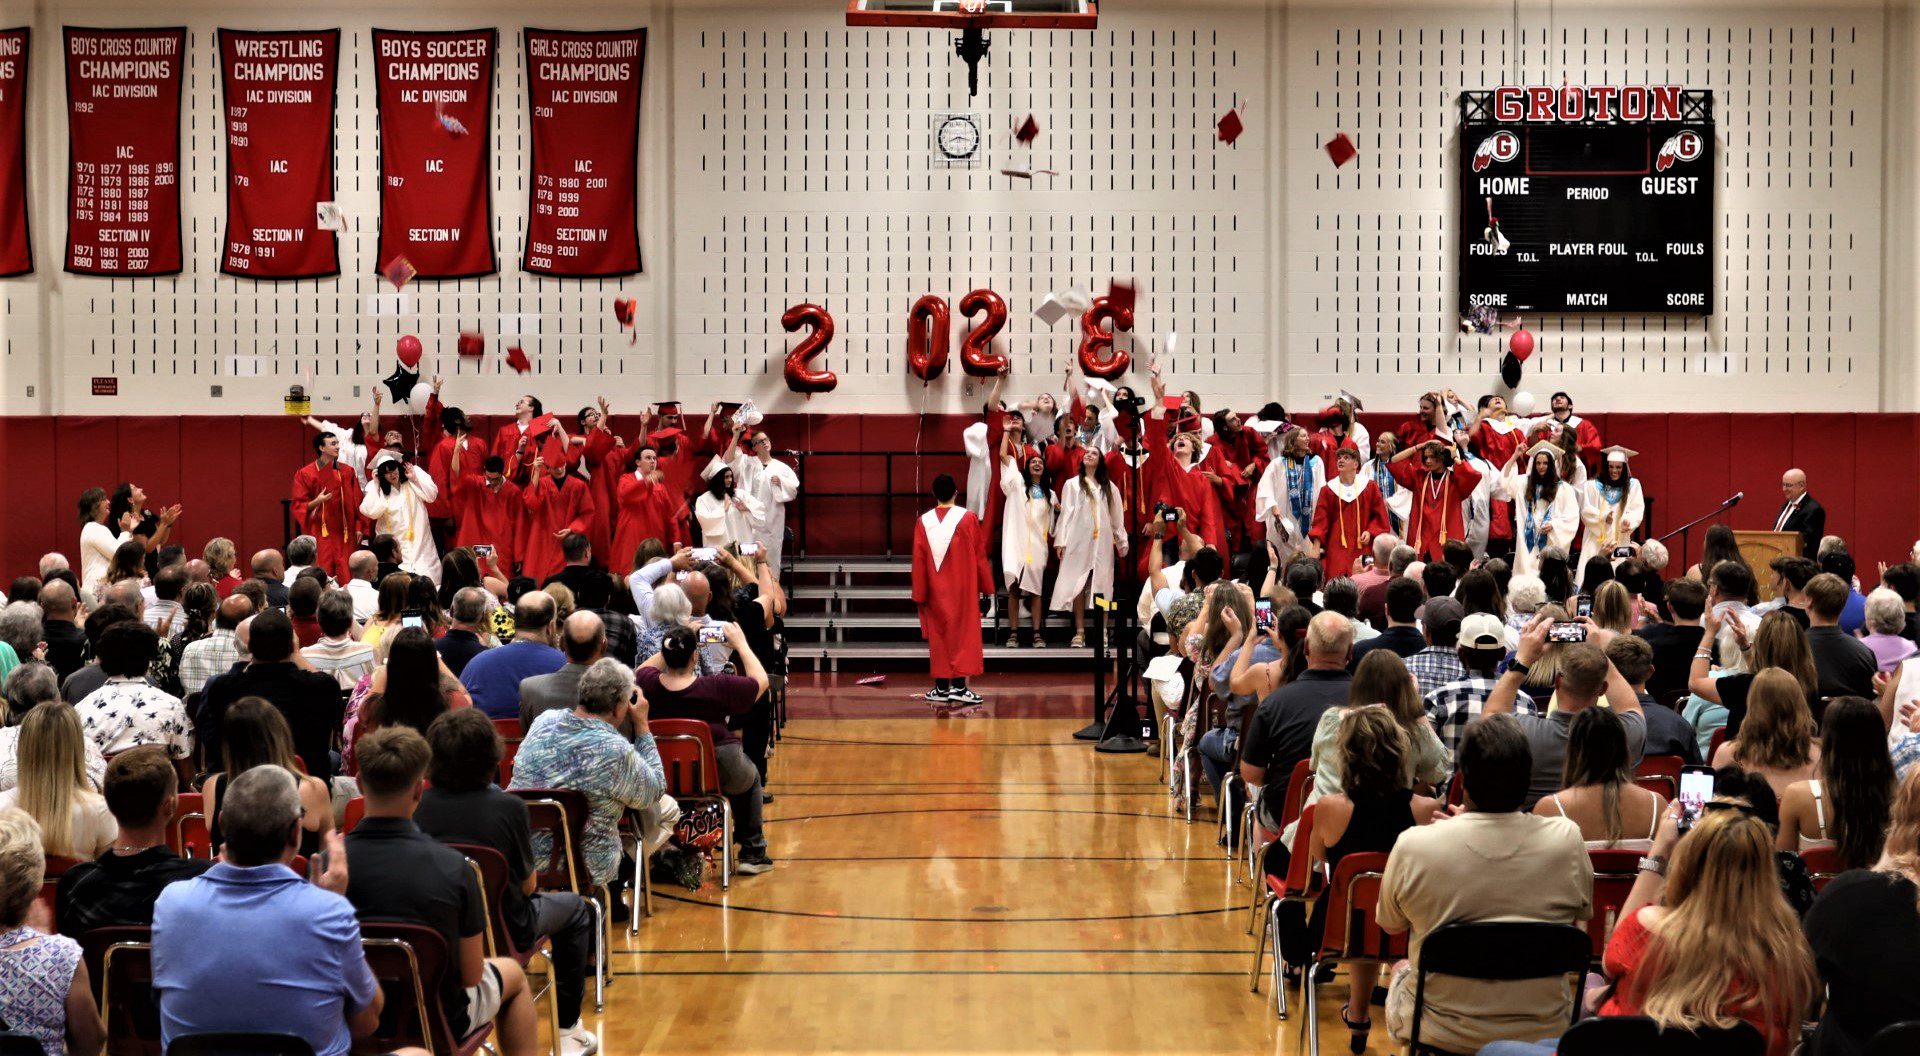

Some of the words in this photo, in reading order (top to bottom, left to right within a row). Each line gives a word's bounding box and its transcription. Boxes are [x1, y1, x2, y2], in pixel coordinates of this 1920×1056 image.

[72, 38, 96, 55] BOYS
[100, 38, 131, 56] CROSS
[135, 37, 177, 55] COUNTRY
[235, 40, 323, 58] WRESTLING
[381, 39, 420, 58] BOYS
[427, 39, 486, 58] SOCCER
[530, 39, 558, 57] GIRLS
[562, 40, 592, 58] CROSS
[596, 39, 638, 58] COUNTRY
[80, 60, 170, 78] CHAMPIONS
[234, 62, 324, 81] CHAMPIONS
[389, 62, 479, 80] CHAMPIONS
[540, 62, 630, 81] CHAMPIONS
[92, 85, 109, 97] IAC
[114, 85, 158, 97] DIVISION
[247, 90, 263, 102] IAC
[268, 90, 312, 103] DIVISION
[402, 90, 418, 102] IAC
[423, 90, 467, 103] DIVISION
[552, 90, 569, 102] IAC
[573, 90, 618, 103] DIVISION
[1494, 85, 1683, 121] GROTON
[1496, 135, 1512, 156] G
[1680, 134, 1696, 156] G
[116, 146, 134, 158] IAC
[100, 164, 121, 174] 1977
[128, 164, 149, 174] 1985
[270, 160, 288, 173] IAC
[426, 160, 444, 172] IAC
[575, 160, 592, 172] IAC
[101, 176, 121, 186] 1979
[128, 176, 149, 186] 1986
[155, 175, 174, 185] 2000
[559, 178, 580, 188] 1980
[586, 178, 607, 188] 2001
[1480, 178, 1530, 195] HOME
[1641, 177, 1698, 195] GUEST
[101, 188, 121, 198] 1980
[128, 188, 148, 198] 1987
[559, 192, 579, 202] 1999
[1567, 188, 1609, 200] PERIOD
[100, 200, 121, 210] 1981
[128, 200, 148, 210] 1988
[100, 212, 121, 222] 1984
[128, 212, 148, 222] 1989
[558, 207, 579, 217] 2000
[99, 229, 138, 242] SECTION
[141, 229, 150, 242] IV
[253, 228, 292, 241] SECTION
[295, 229, 303, 241] IV
[409, 228, 448, 241] SECTION
[451, 228, 460, 241] IV
[556, 228, 595, 241] SECTION
[599, 229, 607, 241] IV
[74, 244, 93, 256] 1971
[100, 247, 118, 257] 1981
[128, 248, 149, 258] 2000
[231, 242, 250, 254] 1978
[558, 246, 578, 256] 2001
[1550, 244, 1594, 256] PLAYER
[1598, 244, 1628, 256] FOUL
[1666, 243, 1704, 255] FOULS
[530, 256, 551, 268] 2000
[1516, 253, 1539, 262] T.O.L.
[1635, 252, 1658, 262] T.O.L.
[128, 260, 149, 269] 2007
[1469, 294, 1508, 306] SCORE
[1566, 294, 1608, 306] MATCH
[1666, 294, 1704, 306] SCORE
